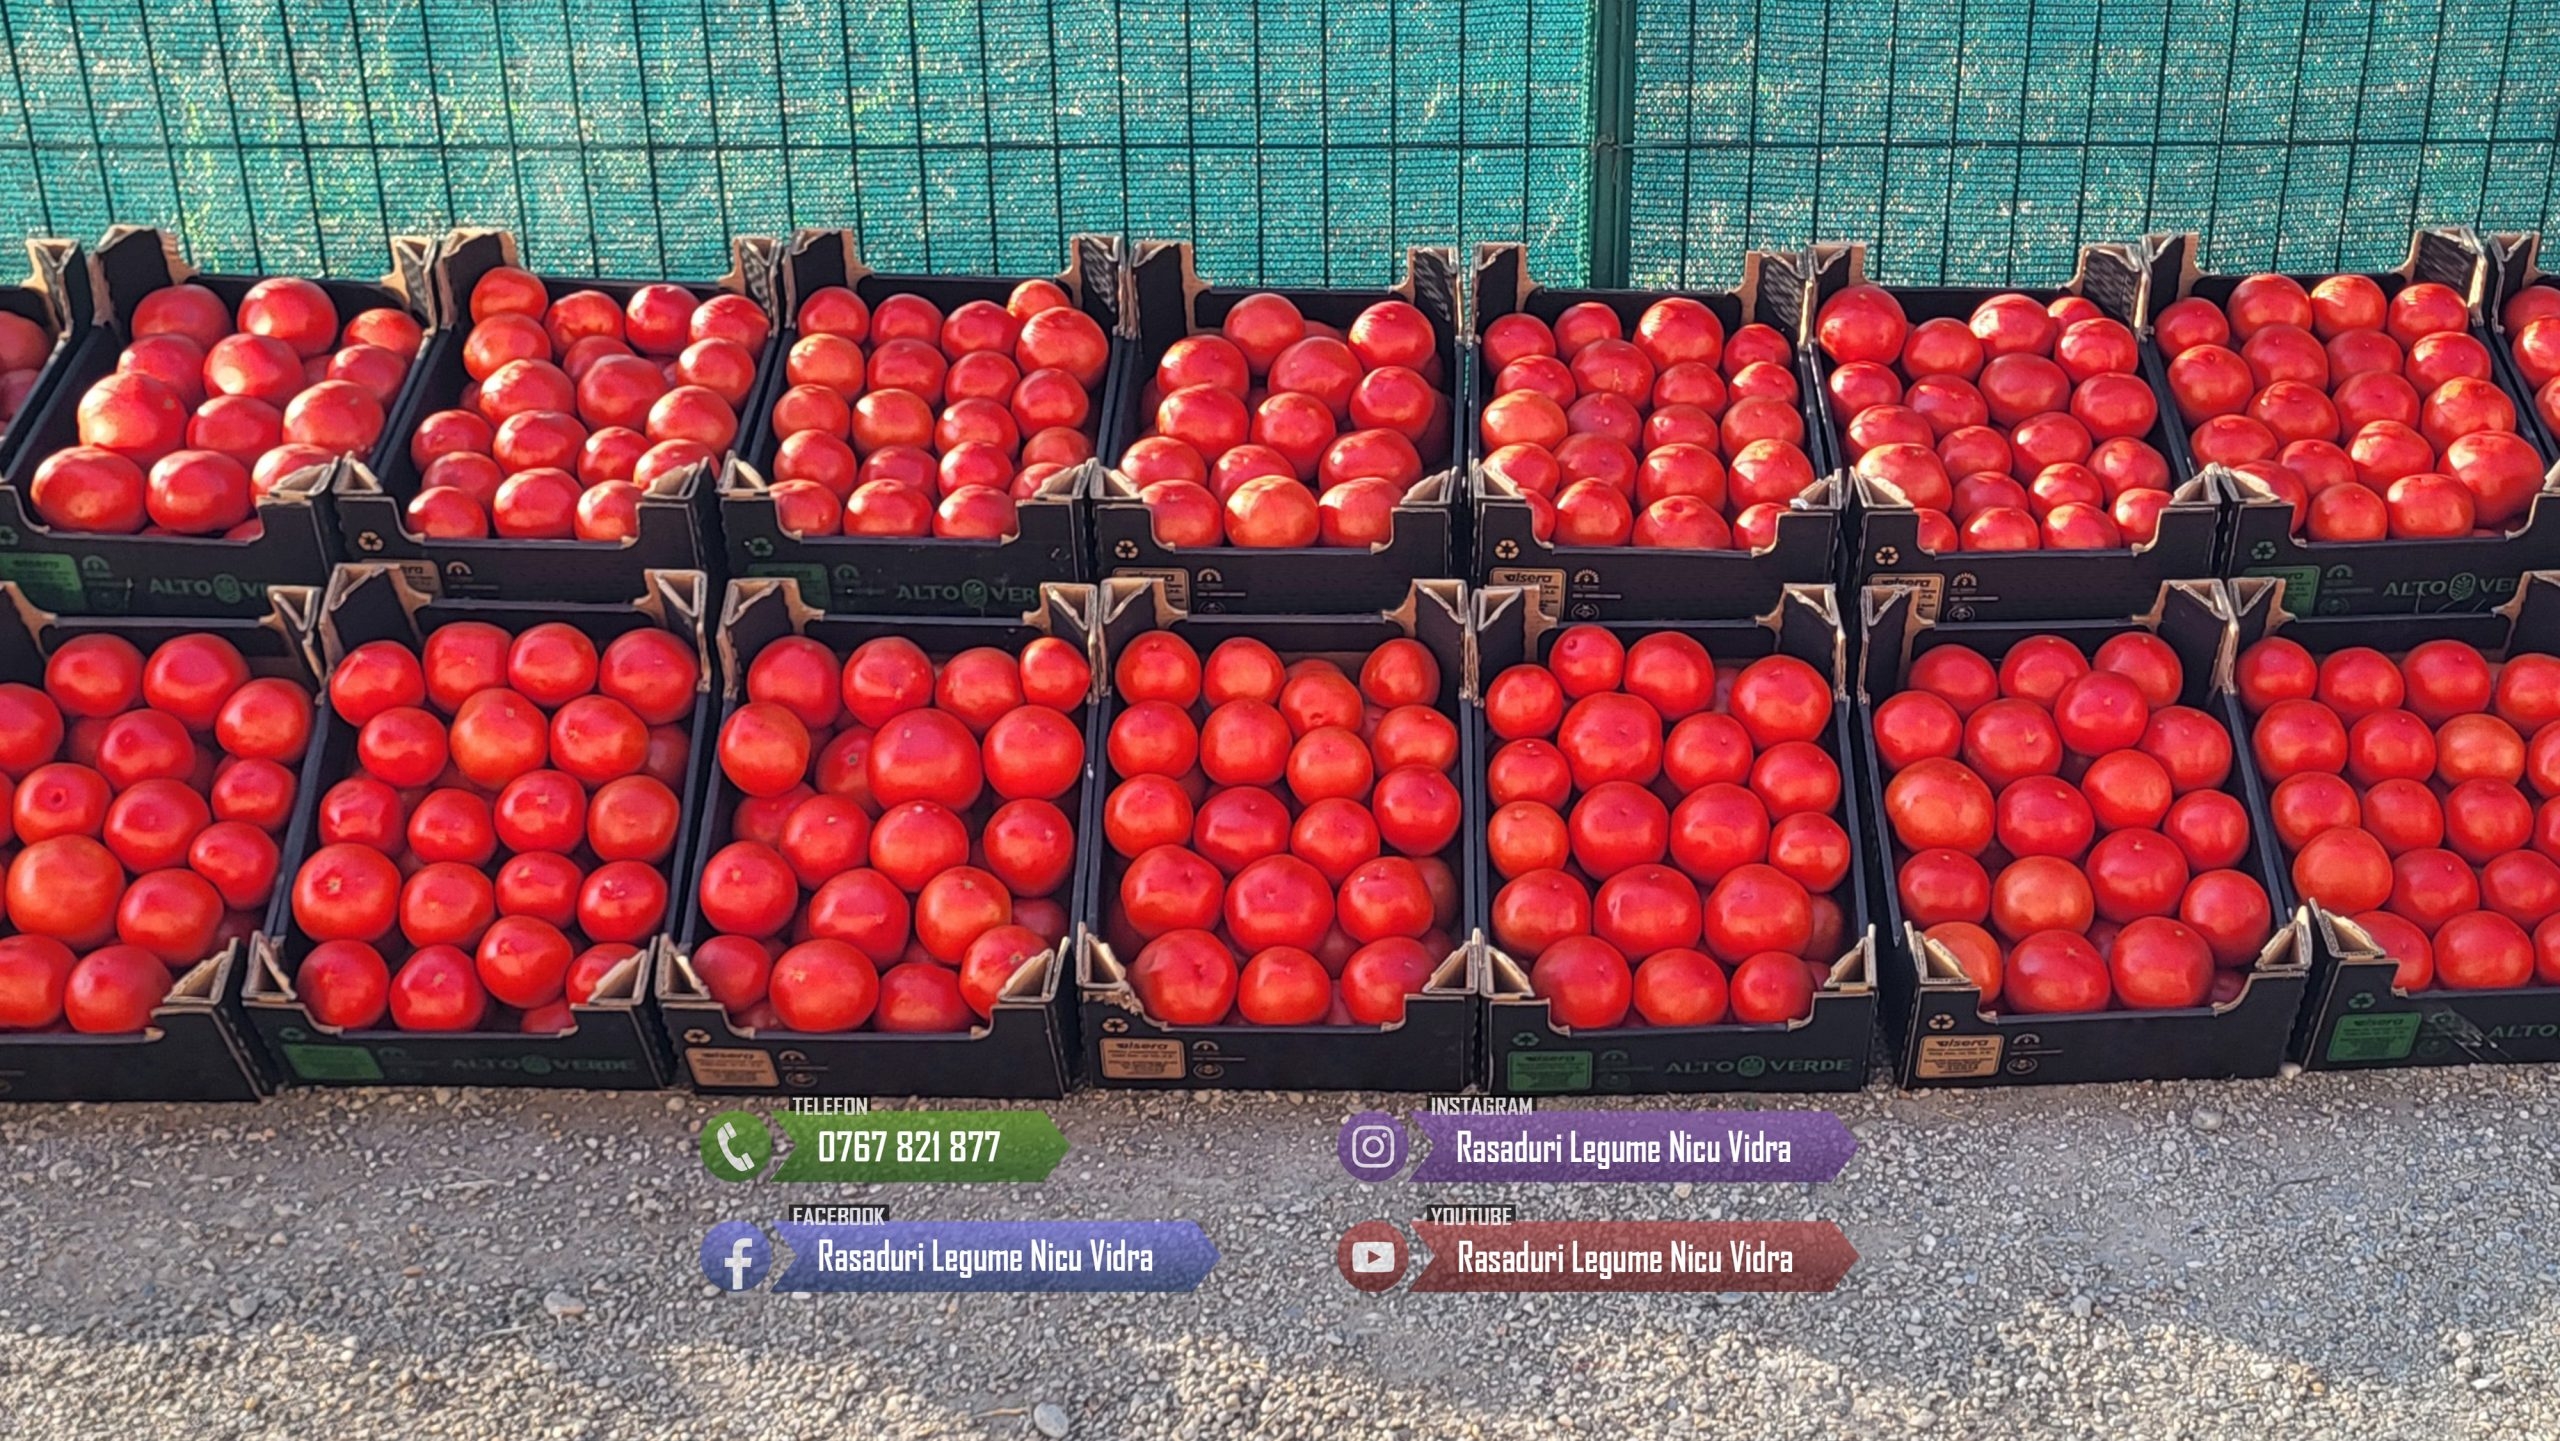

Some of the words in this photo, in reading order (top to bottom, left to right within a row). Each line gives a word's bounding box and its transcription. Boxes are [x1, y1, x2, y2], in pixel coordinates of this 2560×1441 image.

[150, 578, 212, 596] ALTO
[895, 585, 960, 601] ALTO
[2383, 581, 2447, 597] ALTO
[2488, 1024, 2558, 1039] ALTO
[452, 1058, 519, 1070] ALTO
[1665, 1061, 1735, 1074] ALTO
[1769, 1058, 1853, 1073] VERDE
